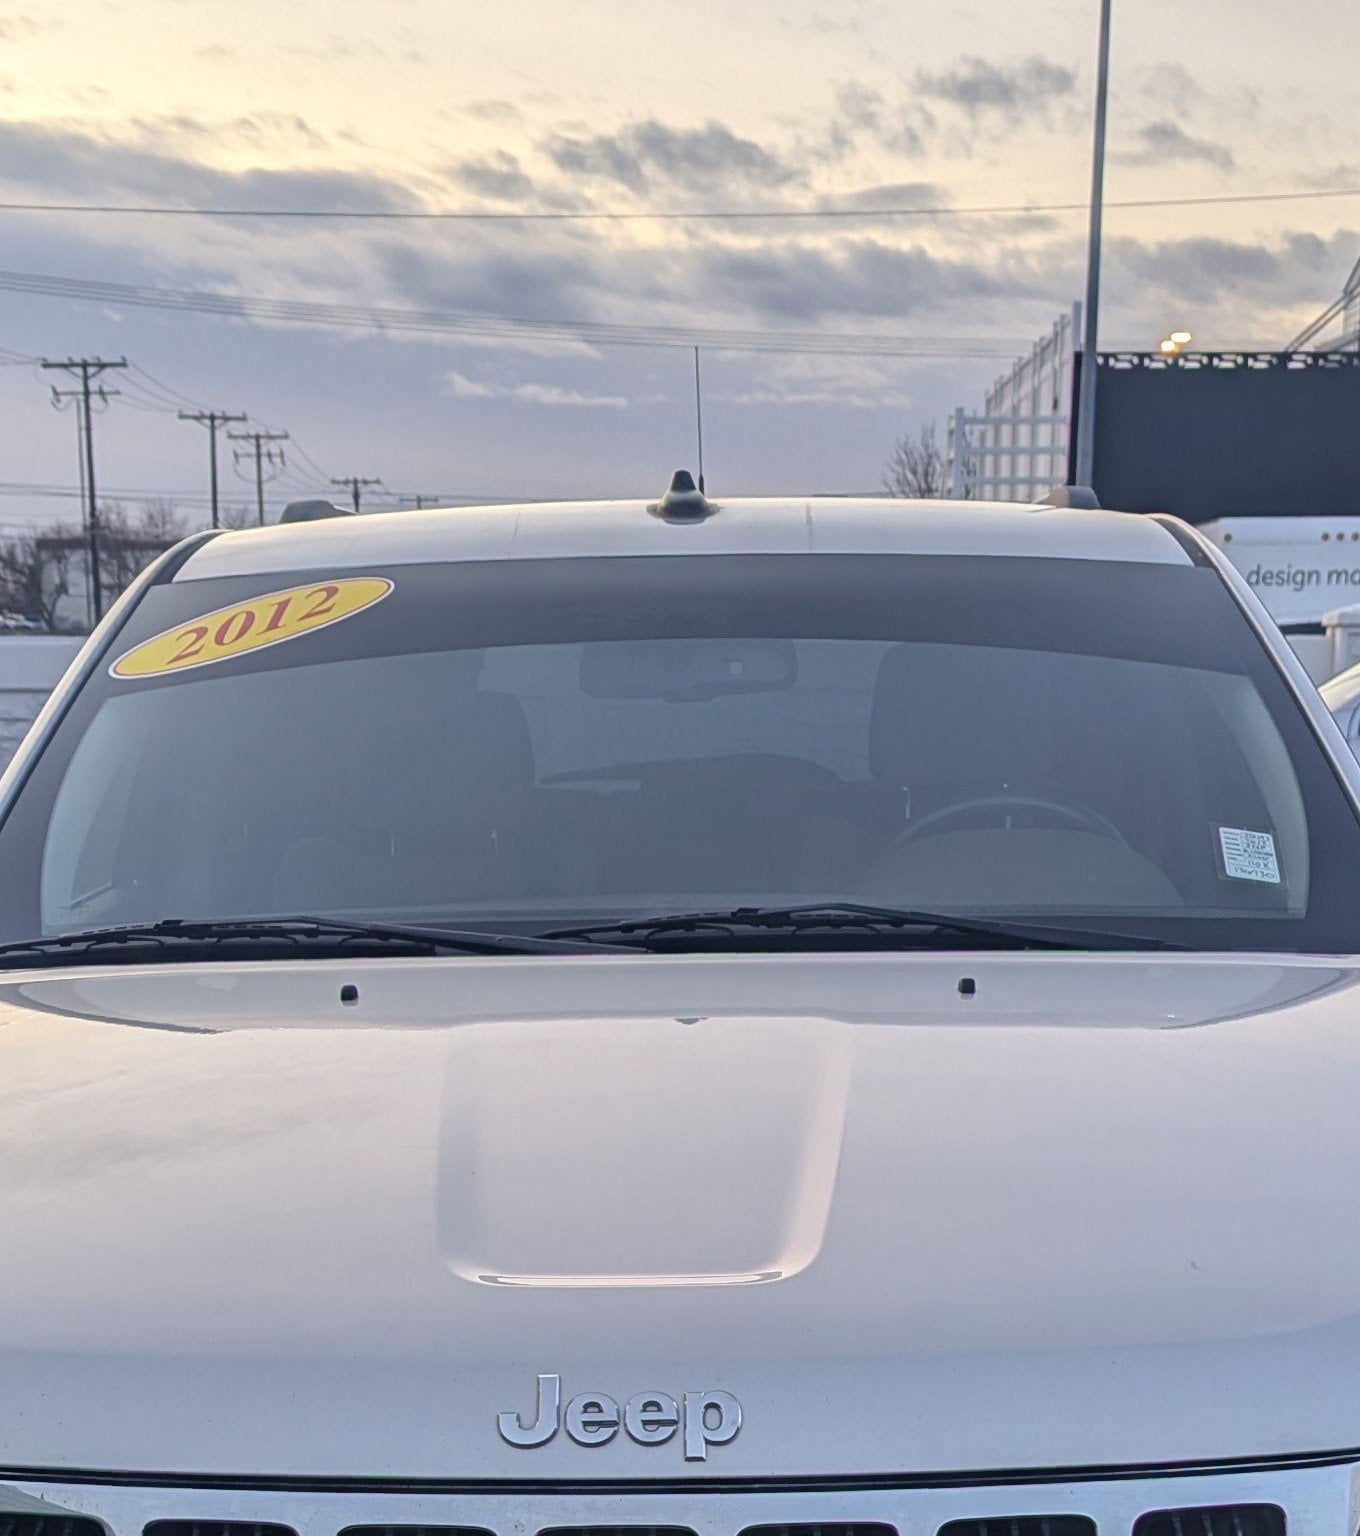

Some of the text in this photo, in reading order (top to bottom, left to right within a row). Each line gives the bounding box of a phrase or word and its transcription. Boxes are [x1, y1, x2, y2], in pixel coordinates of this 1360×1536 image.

[1246, 564, 1321, 592] design
[165, 585, 340, 665] 2012
[497, 1374, 743, 1462] Jeep
